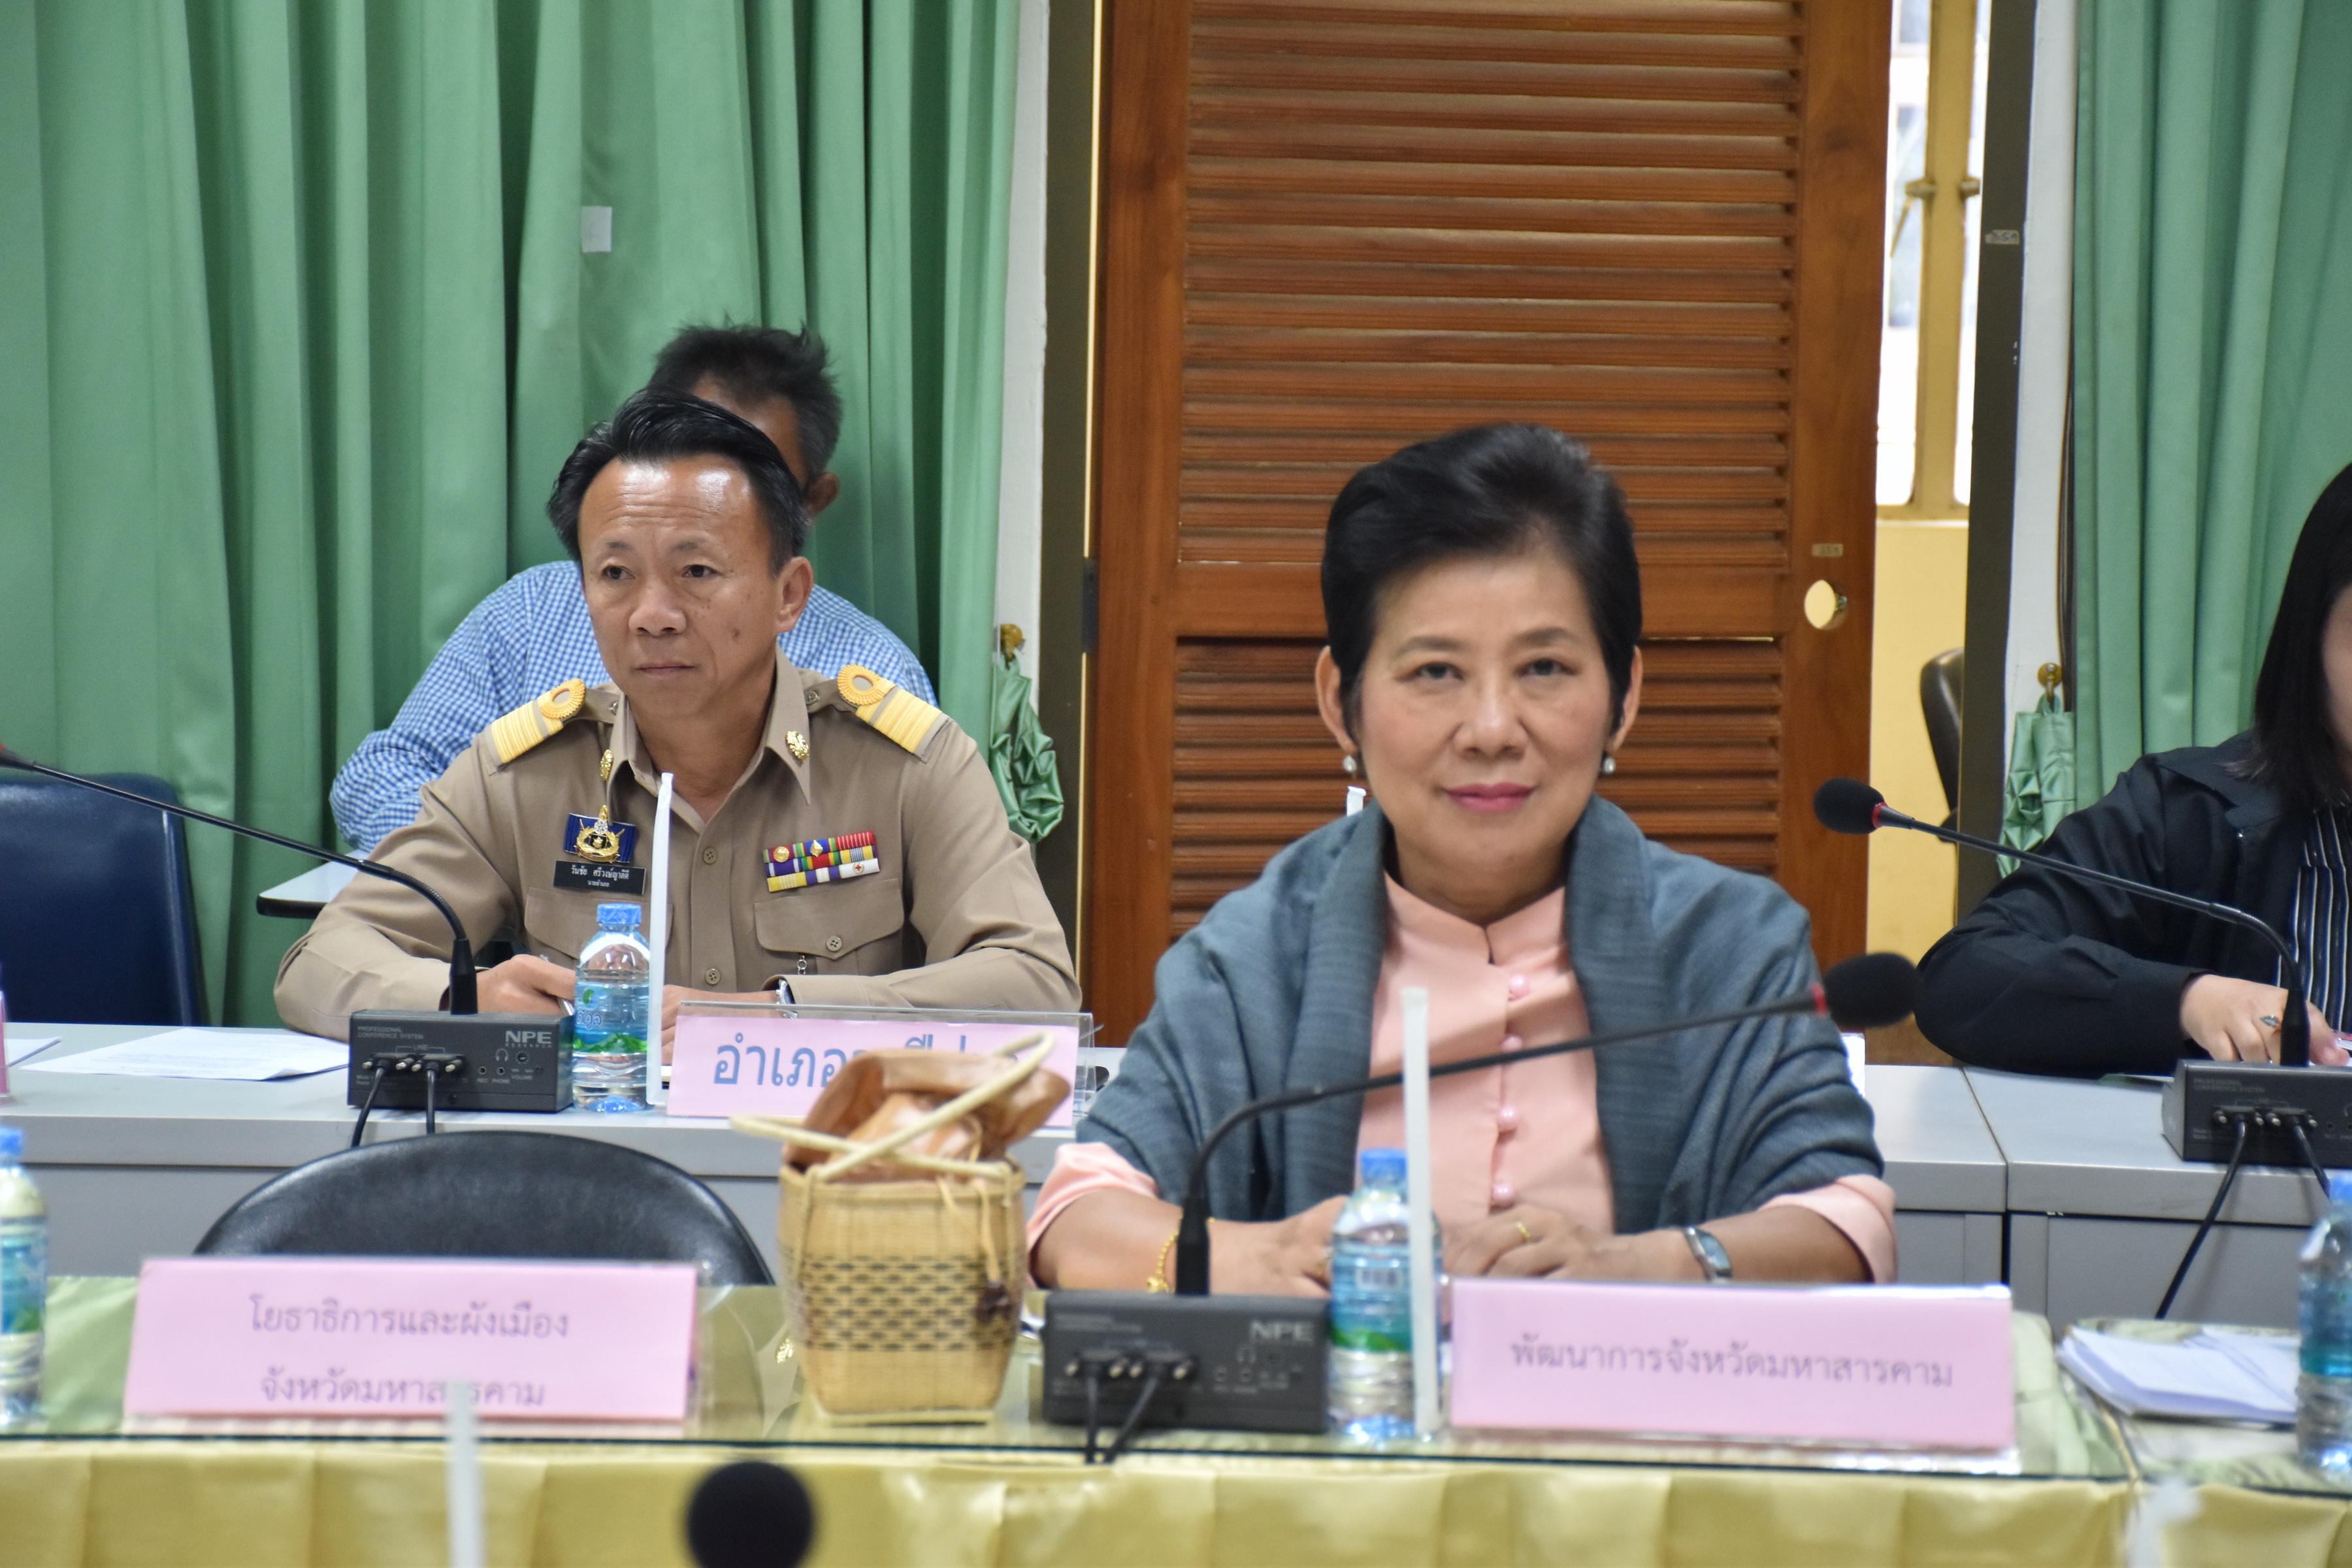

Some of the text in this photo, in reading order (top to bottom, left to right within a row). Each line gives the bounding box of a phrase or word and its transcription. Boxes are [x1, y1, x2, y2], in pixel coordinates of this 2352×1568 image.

[505, 1030, 552, 1044] NPE
[249, 1292, 568, 1339] โยธาธิการและผังเมือง
[1249, 1320, 1315, 1342] NPE
[1510, 1331, 1953, 1387] พัฒนาการจังหวัดมหาสารคาม
[261, 1365, 545, 1405] จังหวัดมหาสรคาม
